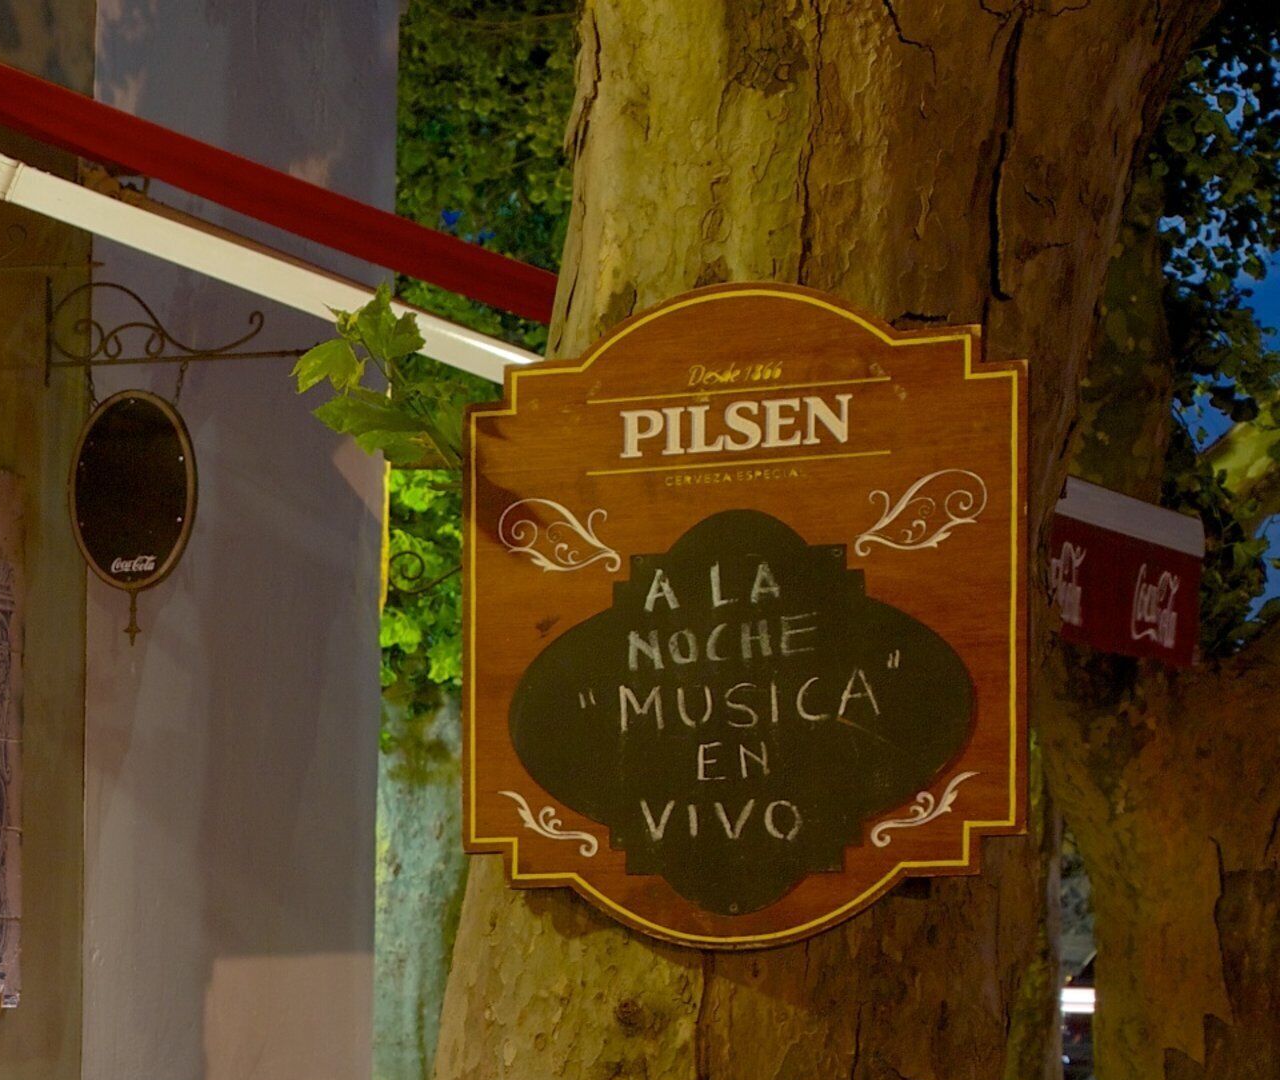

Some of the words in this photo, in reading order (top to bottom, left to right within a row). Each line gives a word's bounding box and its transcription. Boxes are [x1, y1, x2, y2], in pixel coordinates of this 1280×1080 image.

[689, 362, 741, 387] Desde
[620, 393, 853, 459] PILSEN
[665, 473, 733, 487] CERVEZA
[737, 468, 808, 482] ESPECIAL
[111, 555, 158, 573] Coca-Cola
[643, 568, 679, 613] A
[627, 612, 819, 672] NOCHE
[696, 741, 771, 782] EN
[640, 799, 804, 843] VIVO
